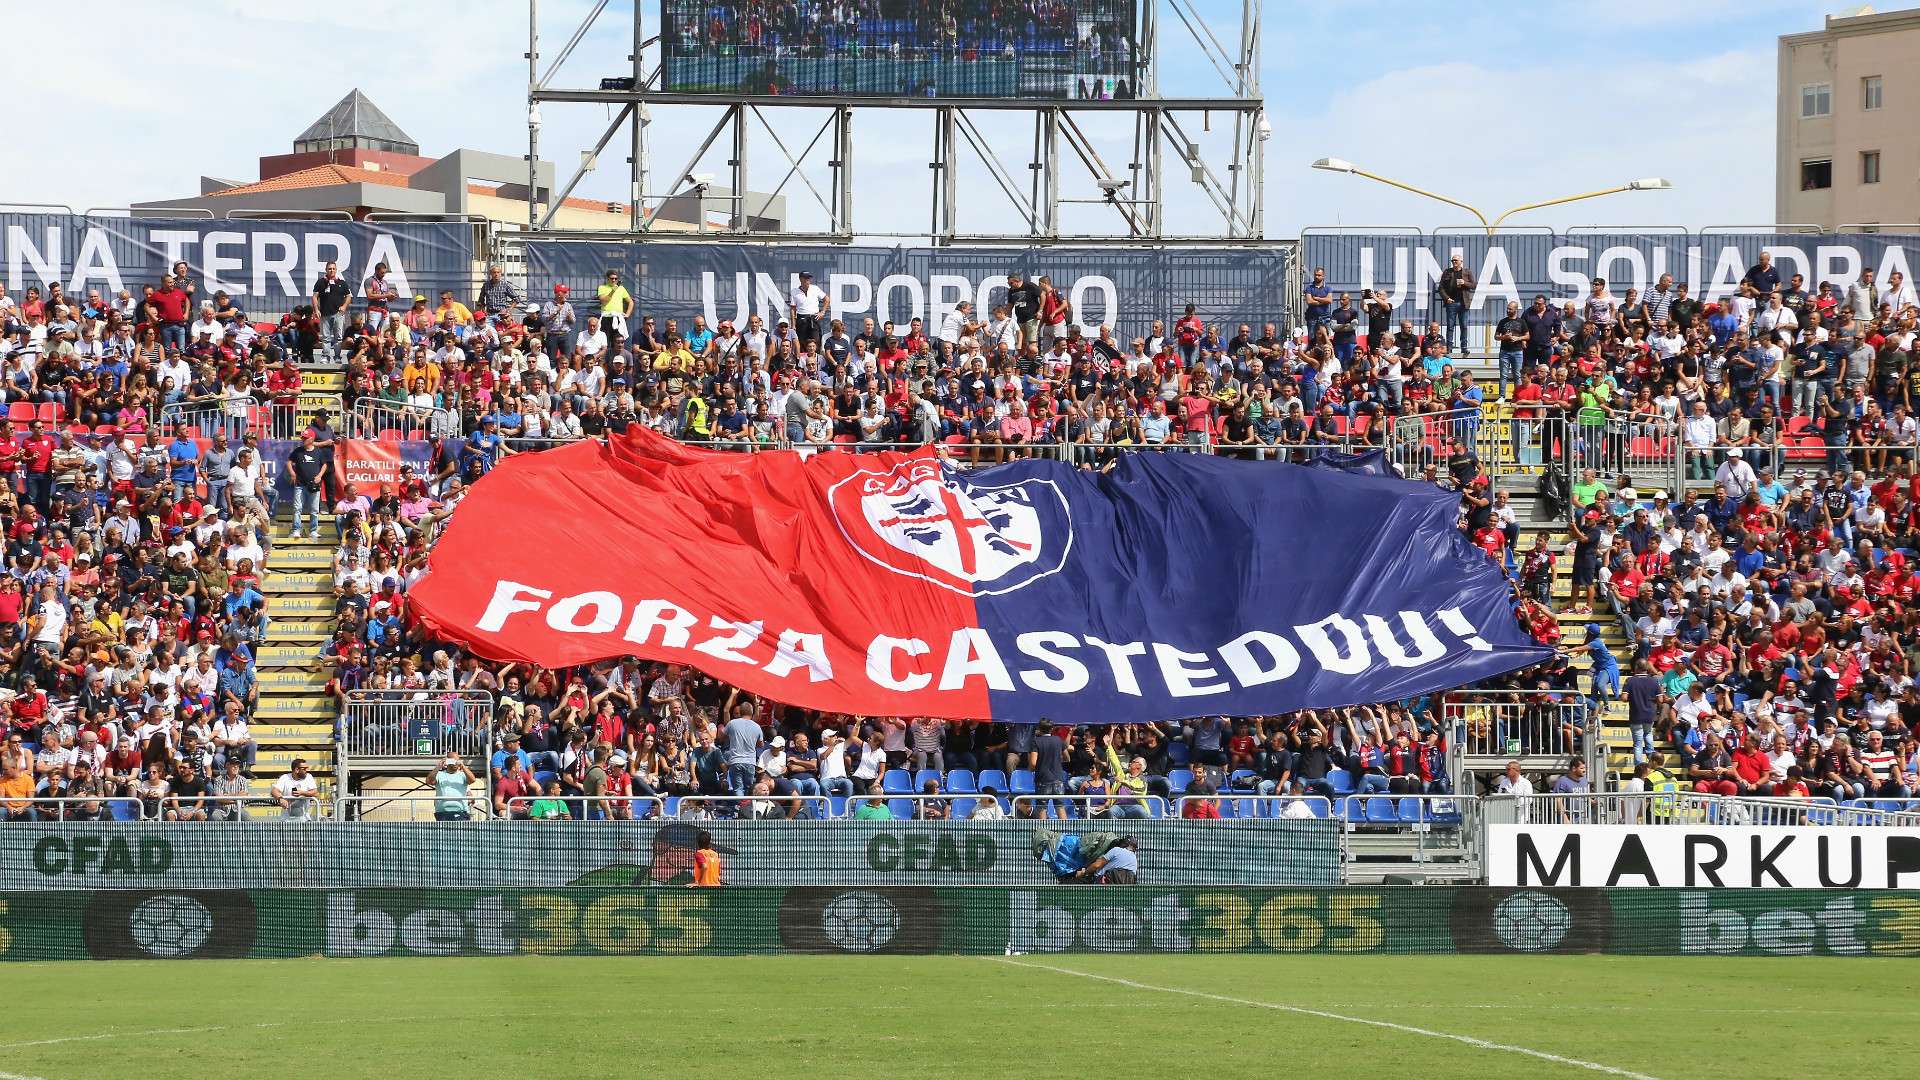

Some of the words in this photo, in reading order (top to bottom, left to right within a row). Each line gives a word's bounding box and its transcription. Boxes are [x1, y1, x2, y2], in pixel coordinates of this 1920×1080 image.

[8, 225, 126, 292] NA
[149, 229, 413, 298] TERRA
[1360, 246, 1523, 310] UNA
[702, 271, 802, 335] UN
[829, 273, 1118, 338] POPOO
[301, 376, 318, 385] FILA
[320, 376, 326, 385] 5
[346, 459, 395, 470] BARATILI
[346, 472, 395, 483] CAGLIARI
[475, 579, 834, 683] FORZA
[865, 606, 1493, 697] CASTEDDU!
[297, 701, 303, 710] 7
[33, 836, 174, 876] CFAD
[867, 833, 997, 873] CFAD
[1516, 833, 1920, 887] MARKUP
[326, 890, 713, 954] bet365
[1009, 889, 1384, 953] bet365
